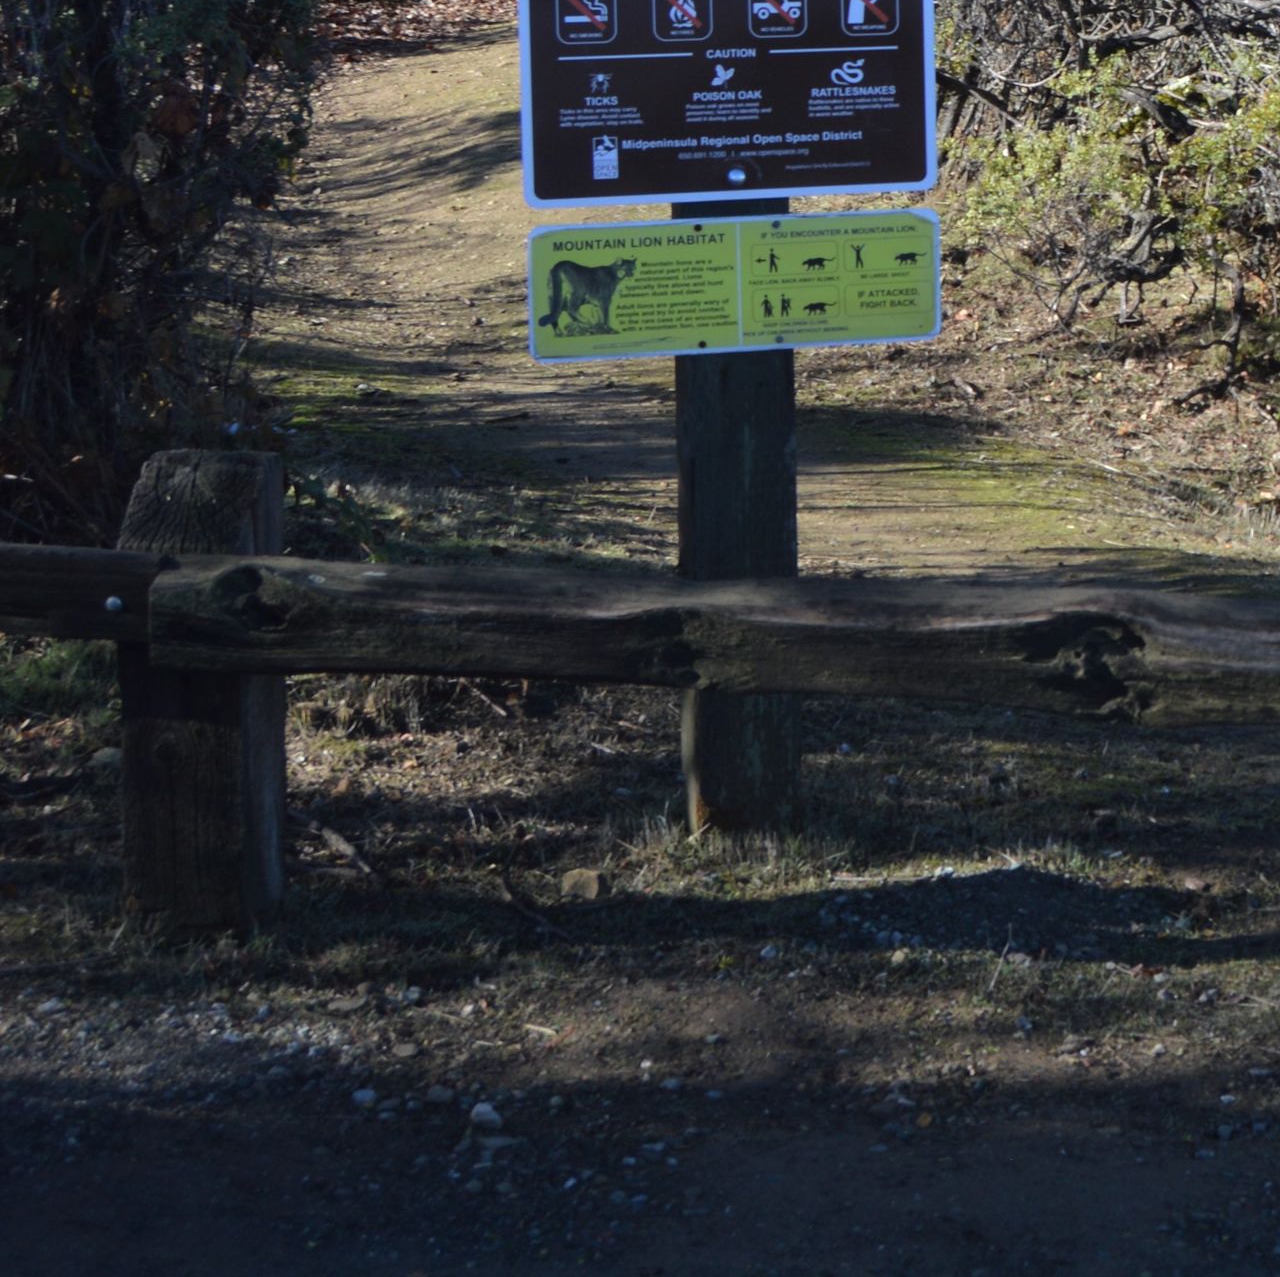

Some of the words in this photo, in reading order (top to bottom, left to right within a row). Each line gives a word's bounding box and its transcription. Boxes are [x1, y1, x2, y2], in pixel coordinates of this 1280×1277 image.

[706, 49, 756, 58] CAUTION
[693, 92, 735, 101] POISON
[738, 91, 762, 99] OAK
[811, 85, 896, 98] RATTLESNAKES
[585, 96, 618, 105] TICKS
[622, 138, 697, 149] Midpeninsula
[700, 136, 750, 147] Regional
[753, 134, 782, 145] Open
[786, 133, 819, 143] Space
[822, 131, 863, 140] District
[761, 231, 767, 239] IF
[771, 230, 788, 239] YOU
[790, 228, 841, 238] ENCOUNTER
[844, 228, 848, 236] A
[851, 225, 894, 235] MOUNTAIN
[552, 239, 625, 251] MOUNTAIN
[631, 237, 662, 247] LION
[667, 233, 726, 247] HABITAT
[858, 290, 864, 298] IF
[859, 300, 886, 309] FIGHT
